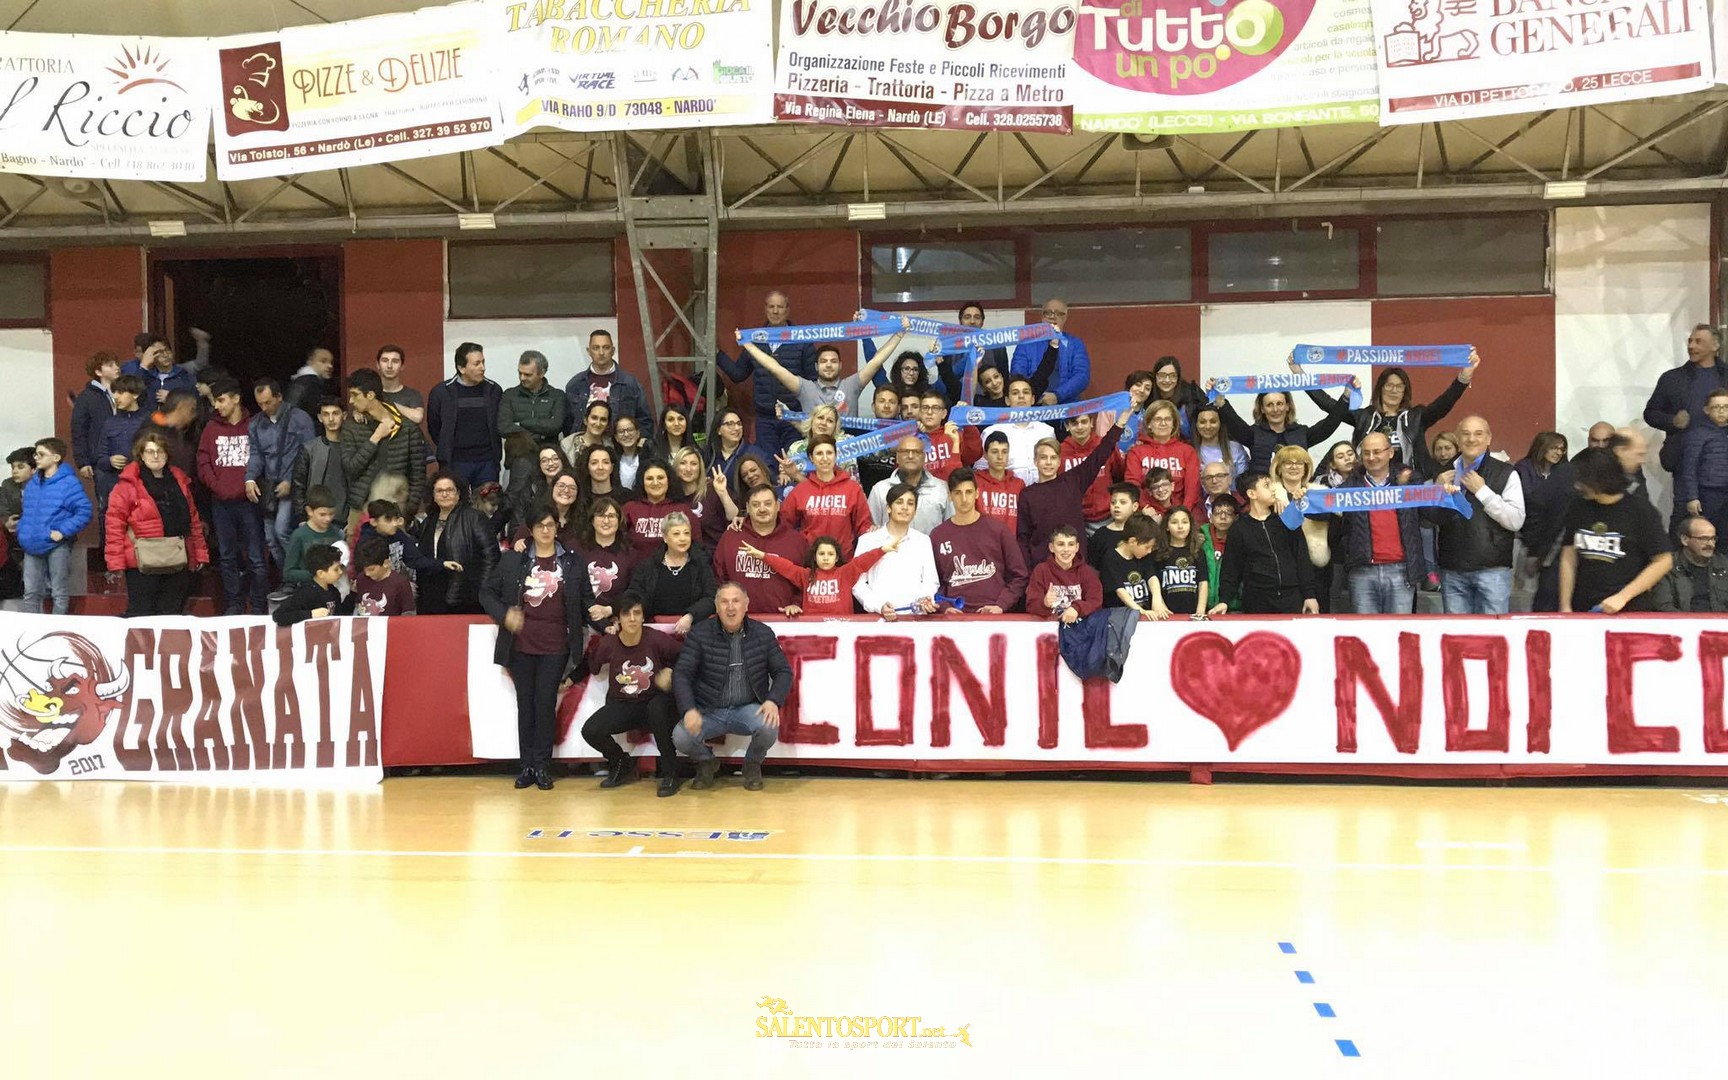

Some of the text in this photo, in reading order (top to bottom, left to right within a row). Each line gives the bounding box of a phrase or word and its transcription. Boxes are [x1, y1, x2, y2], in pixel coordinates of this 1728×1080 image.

[552, 22, 706, 54] ROMANO
[792, 0, 1075, 48] Vecchio Borgo
[1079, 2, 1272, 51] Tutto
[1490, 0, 1695, 56] GENERALI
[293, 64, 357, 103] PIZZE
[378, 48, 463, 93] DELIZIE
[789, 52, 1066, 78] Organizzazione Feste e Piccoli Ricevimenti
[1116, 53, 1158, 78] un
[788, 73, 849, 93] Pizzeria
[868, 77, 934, 98] Trattoria
[953, 83, 994, 101] Pizza
[1001, 89, 1009, 101] a
[1016, 84, 1064, 102] Metro
[1433, 96, 1458, 107] VIA
[1461, 93, 1476, 105] DI
[1582, 77, 1599, 90] 25
[1602, 71, 1653, 87] LECCE
[42, 81, 195, 147] Riccio
[541, 99, 560, 114] VIA
[562, 103, 592, 117] RAHO
[596, 105, 616, 117] 9/D
[624, 102, 662, 116] 73048
[785, 102, 802, 115] Via
[805, 103, 843, 120] Regina
[846, 106, 876, 120] Elena
[888, 109, 920, 123] Nardò
[924, 111, 946, 126] (LE)
[965, 112, 990, 126] Cell.
[993, 114, 1063, 127] 328.0255738
[1149, 114, 1213, 129] (LECCE)
[1232, 113, 1262, 126] VIA
[230, 151, 248, 163] Via
[294, 146, 307, 156] 56
[318, 140, 351, 153] Nardò
[354, 137, 375, 150] (Le)
[386, 132, 410, 143] Cell.
[437, 125, 451, 136] 39
[454, 123, 467, 134] 52
[470, 120, 490, 131] 970
[1, 153, 37, 166] Bagno
[806, 494, 847, 509] ANGEL
[940, 541, 952, 555] 45
[113, 617, 378, 771] GRANATA
[1334, 629, 1551, 754] NOI
[70, 755, 104, 775] 2017
